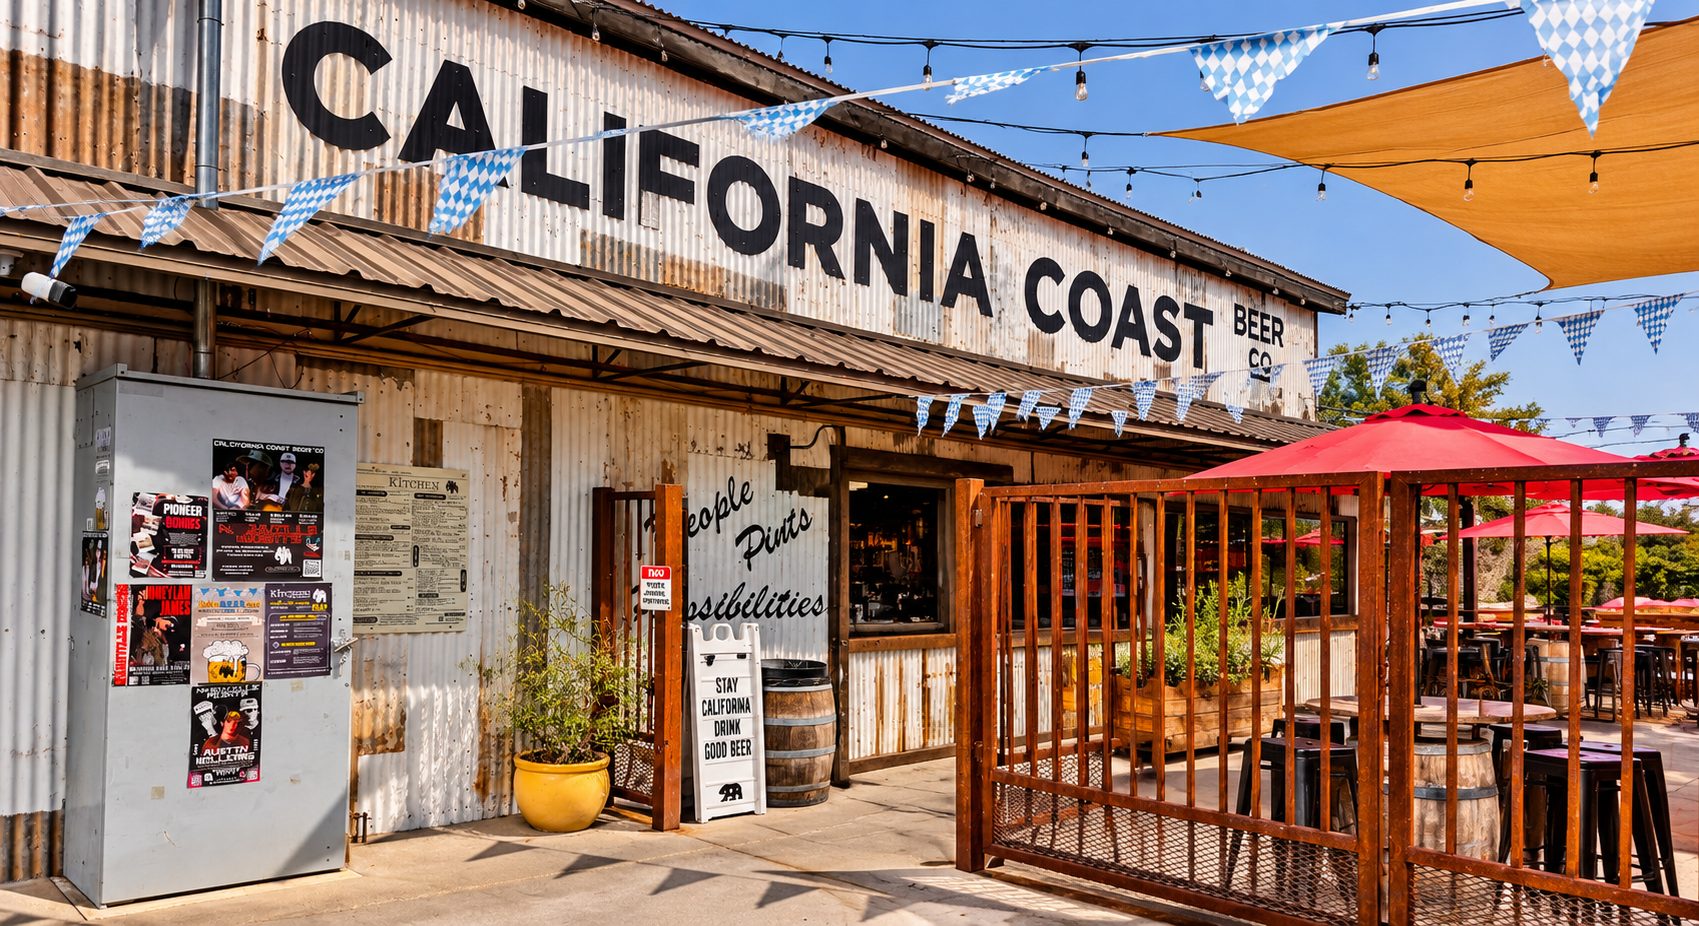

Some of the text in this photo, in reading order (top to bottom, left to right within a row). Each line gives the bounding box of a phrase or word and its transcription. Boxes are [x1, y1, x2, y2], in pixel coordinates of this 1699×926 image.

[282, 21, 1213, 369] CALIFORNIA COAST
[1234, 303, 1284, 348] BEER
[1249, 348, 1272, 374] CO
[389, 477, 439, 491] KITCHEN
[163, 503, 202, 517] PIONEER
[644, 476, 753, 541] eople
[735, 508, 813, 572] Pints
[160, 600, 190, 616] JAMES
[715, 677, 739, 694] STAY
[714, 719, 741, 737] DRINK
[704, 739, 752, 760] GOOD BEER
